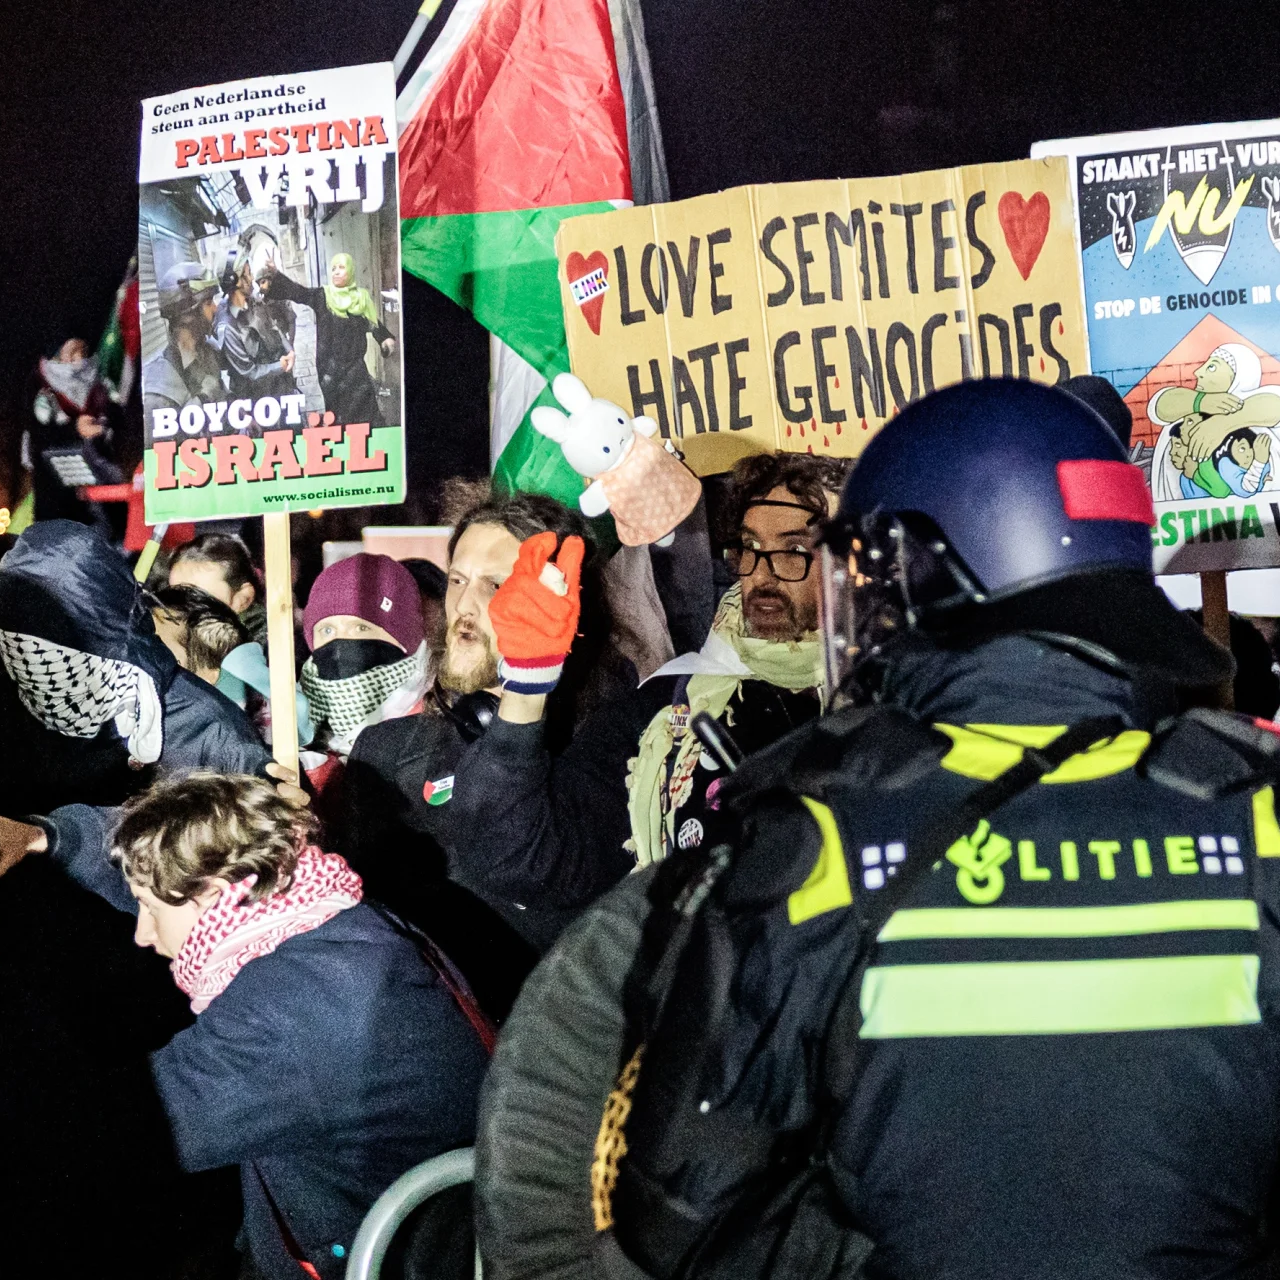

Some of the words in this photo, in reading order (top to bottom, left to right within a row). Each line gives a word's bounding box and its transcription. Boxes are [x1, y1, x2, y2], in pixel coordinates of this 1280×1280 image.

[151, 118, 193, 135] steun
[198, 113, 230, 125] aan
[234, 98, 326, 123] apartheid
[153, 96, 190, 117] Geen
[193, 84, 306, 109] Nederlandse
[175, 115, 388, 169] PALESTINA
[238, 152, 387, 213] VRIJ
[1143, 174, 1255, 254] NU
[613, 228, 733, 327] LOVE
[1094, 298, 1135, 320] STOP
[1139, 295, 1161, 315] DE
[1166, 289, 1248, 312] GENOCIDE
[1251, 286, 1272, 304] IN
[626, 338, 753, 439] HATE
[152, 394, 306, 438] BOYCOT
[153, 411, 388, 491] ISRAËL
[263, 485, 395, 503] www.socialisme.nu
